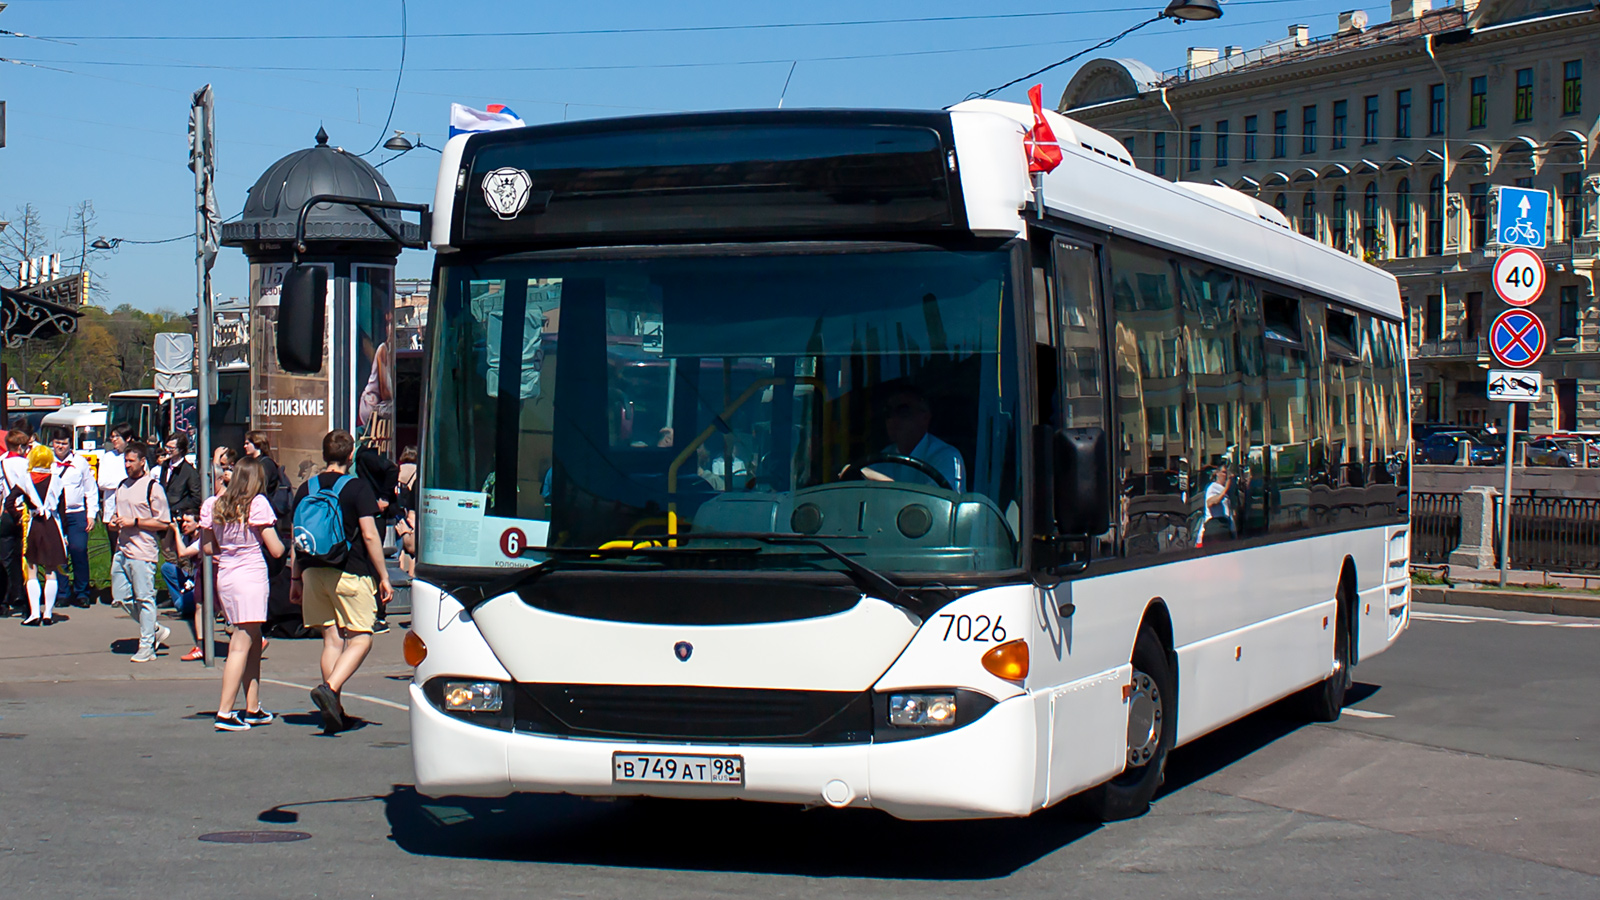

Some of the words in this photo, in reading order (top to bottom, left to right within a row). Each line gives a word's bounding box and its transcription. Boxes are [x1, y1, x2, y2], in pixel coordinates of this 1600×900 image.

[261, 266, 284, 285] 115
[1505, 266, 1535, 288] 40
[507, 532, 519, 554] 6
[939, 614, 1007, 643] 7026
[713, 759, 735, 775] 98
[712, 774, 729, 782] RUS
